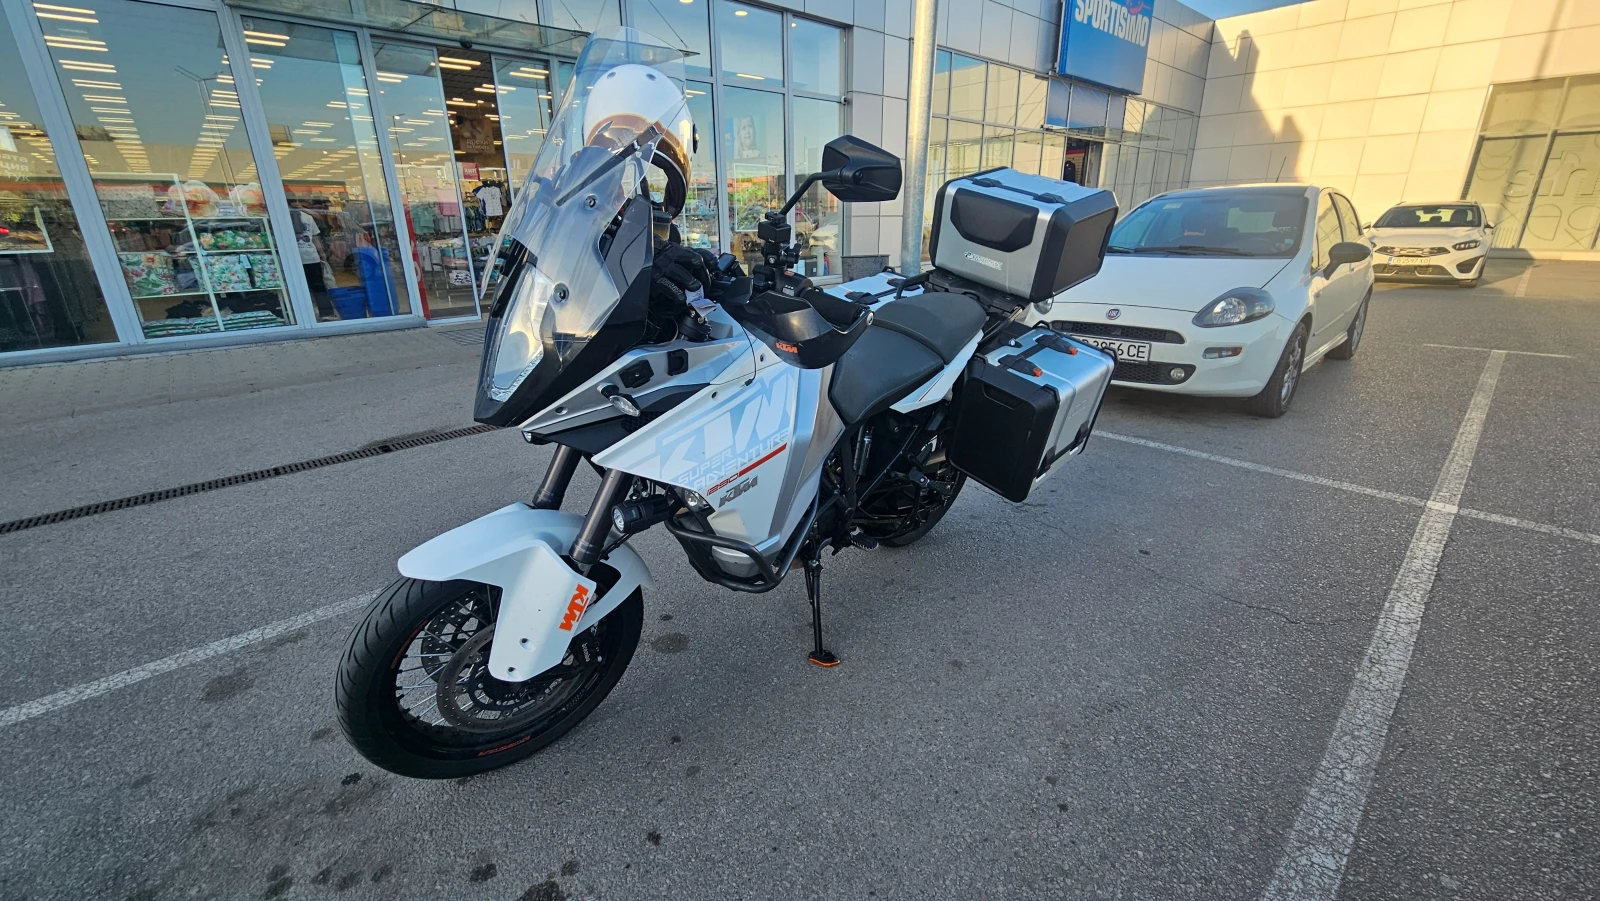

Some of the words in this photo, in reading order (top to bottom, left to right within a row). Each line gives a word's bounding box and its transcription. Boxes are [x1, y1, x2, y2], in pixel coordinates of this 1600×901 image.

[1075, 0, 1150, 47] SPORTISIMO
[775, 342, 799, 354] KTM
[1127, 344, 1146, 358] CE
[678, 447, 733, 484] SUPER
[693, 427, 791, 491] ADVENTURE
[719, 476, 758, 508] KTM
[558, 583, 589, 632] KTM
